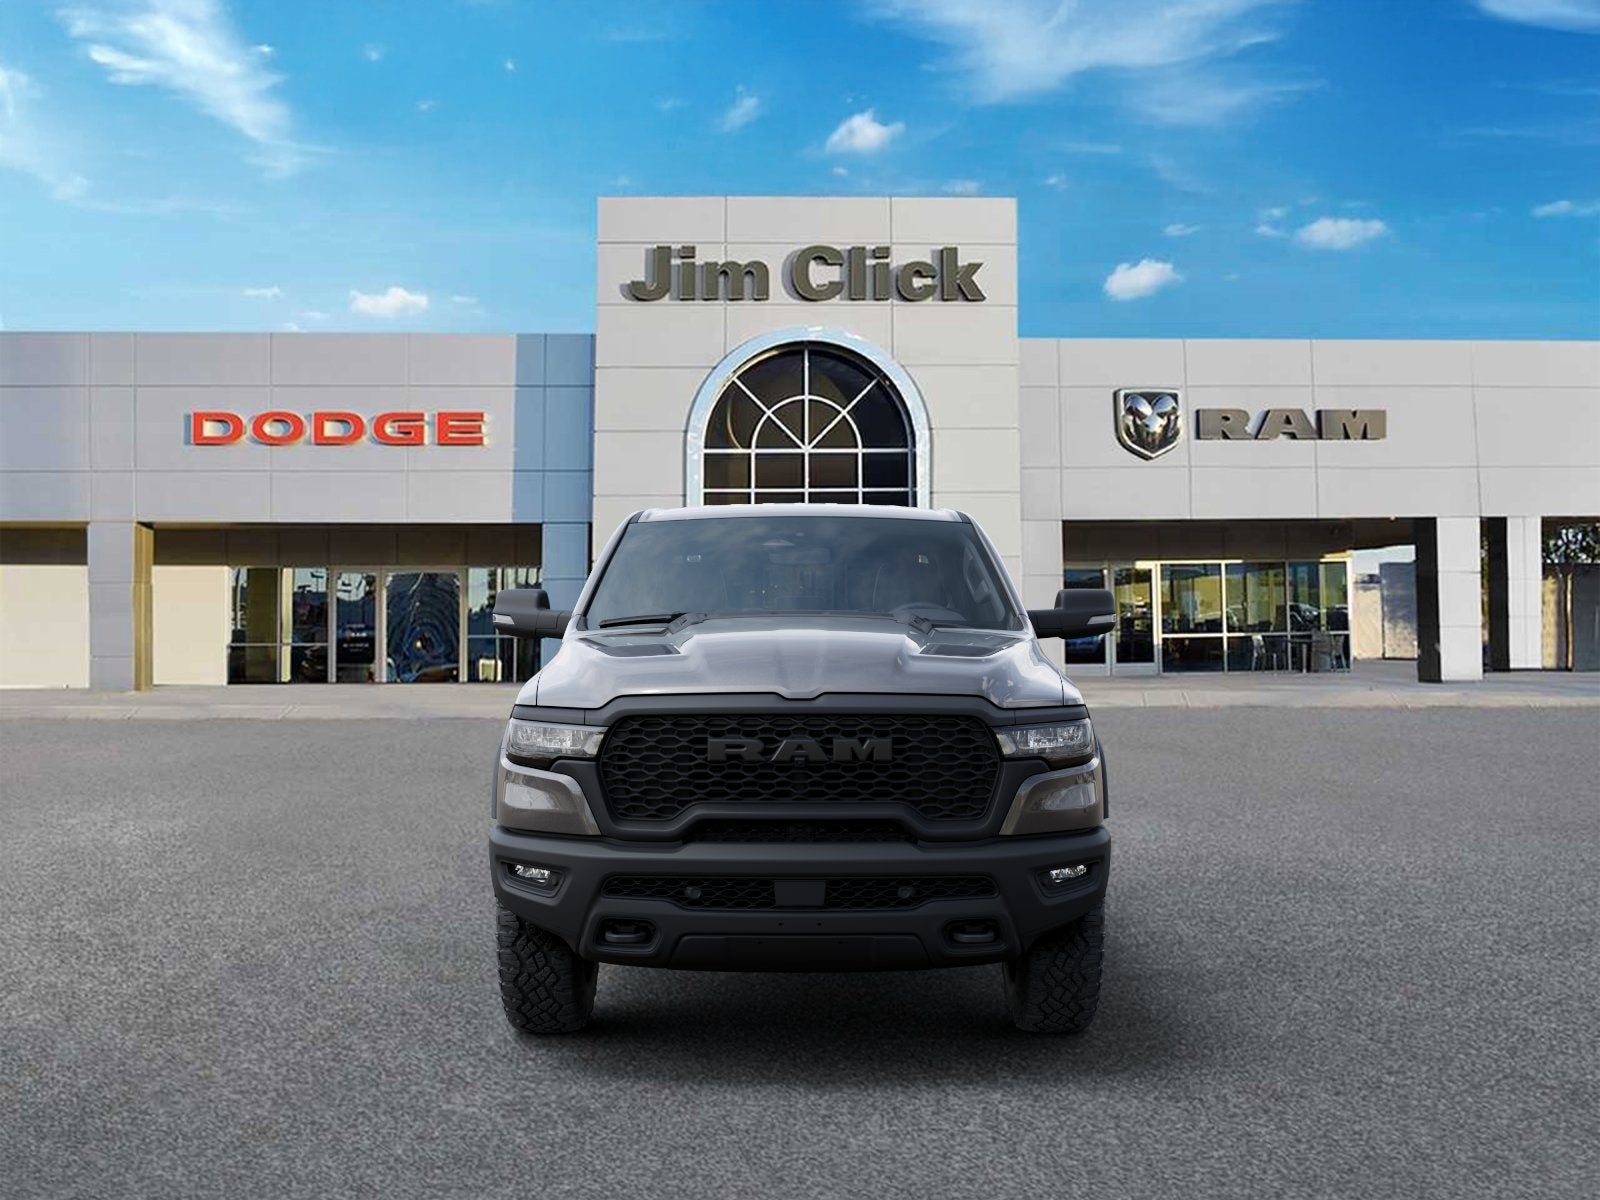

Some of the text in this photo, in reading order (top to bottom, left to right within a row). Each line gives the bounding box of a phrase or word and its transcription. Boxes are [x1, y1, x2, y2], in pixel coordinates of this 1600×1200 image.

[630, 244, 986, 301] Jim Click
[192, 411, 485, 446] DODGE
[1196, 409, 1387, 440] RAM
[707, 738, 893, 762] RAM
